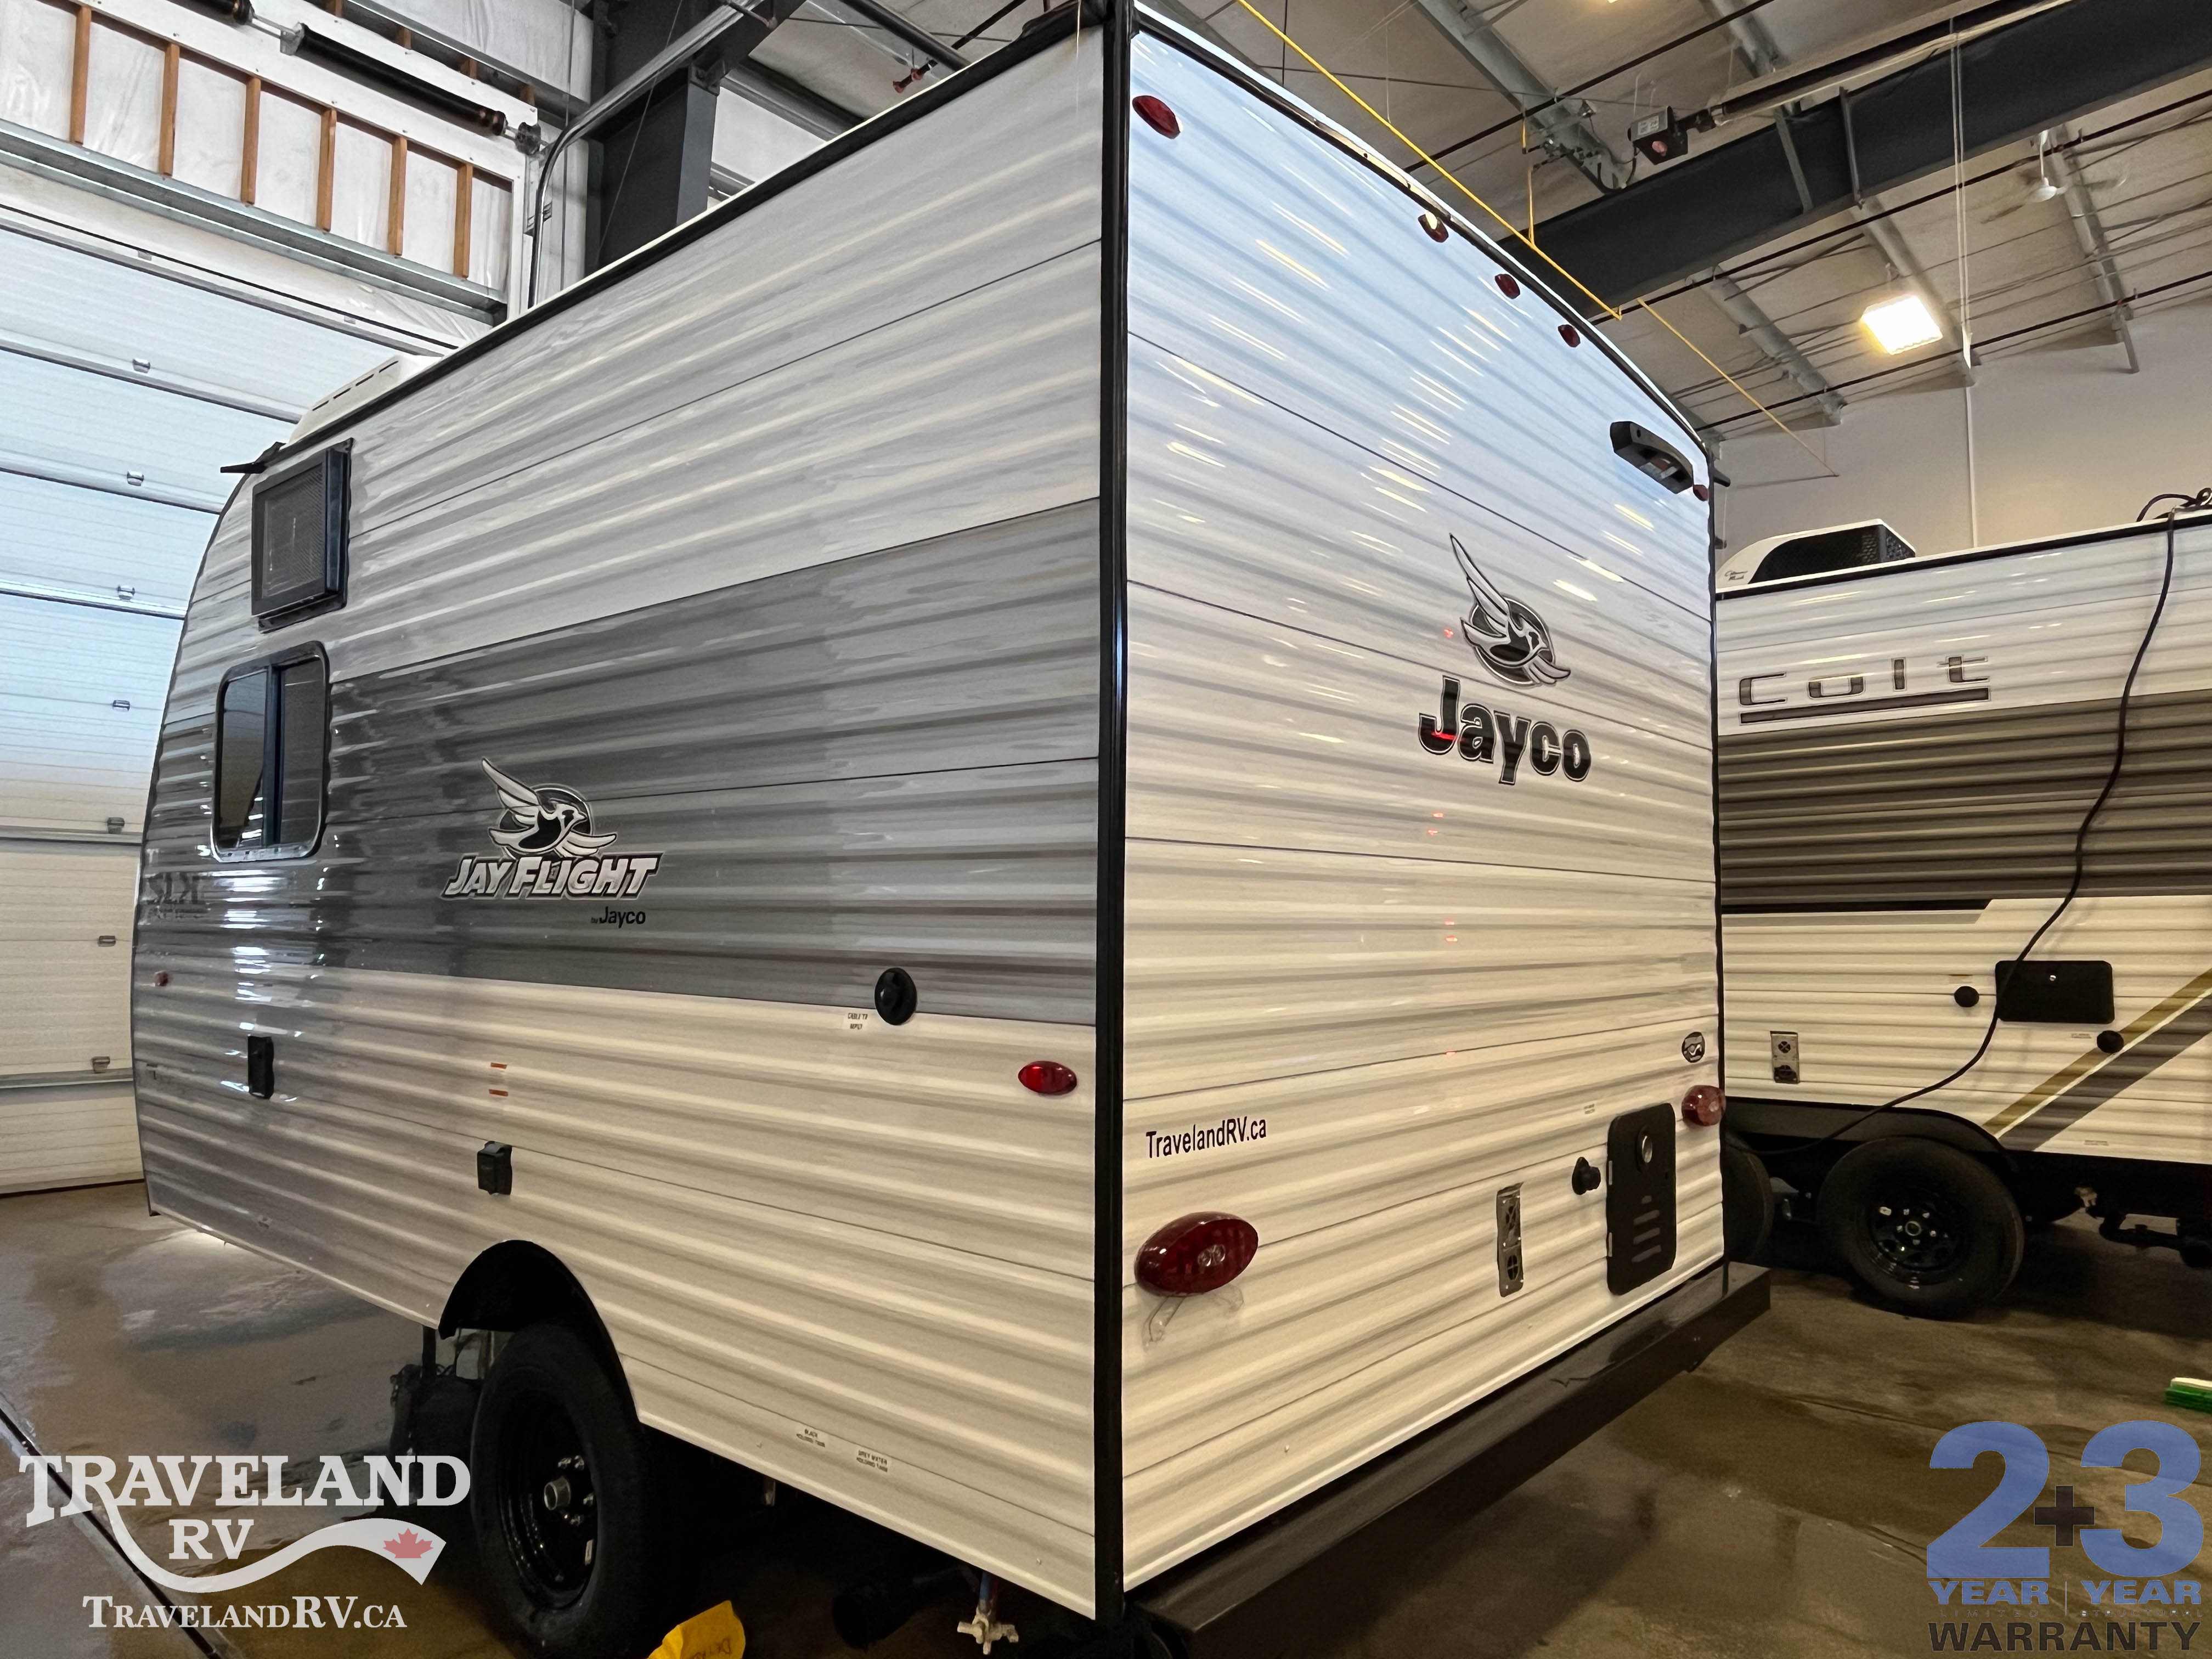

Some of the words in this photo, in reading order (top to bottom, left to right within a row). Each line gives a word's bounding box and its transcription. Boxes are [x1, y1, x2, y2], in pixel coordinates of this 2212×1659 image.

[1418, 675, 1592, 786] Jayco
[442, 855, 514, 899] JAY
[509, 853, 662, 899] FLIGHT
[599, 906, 646, 929] Jayco
[1145, 1116, 1267, 1159] TravelandRV.ca
